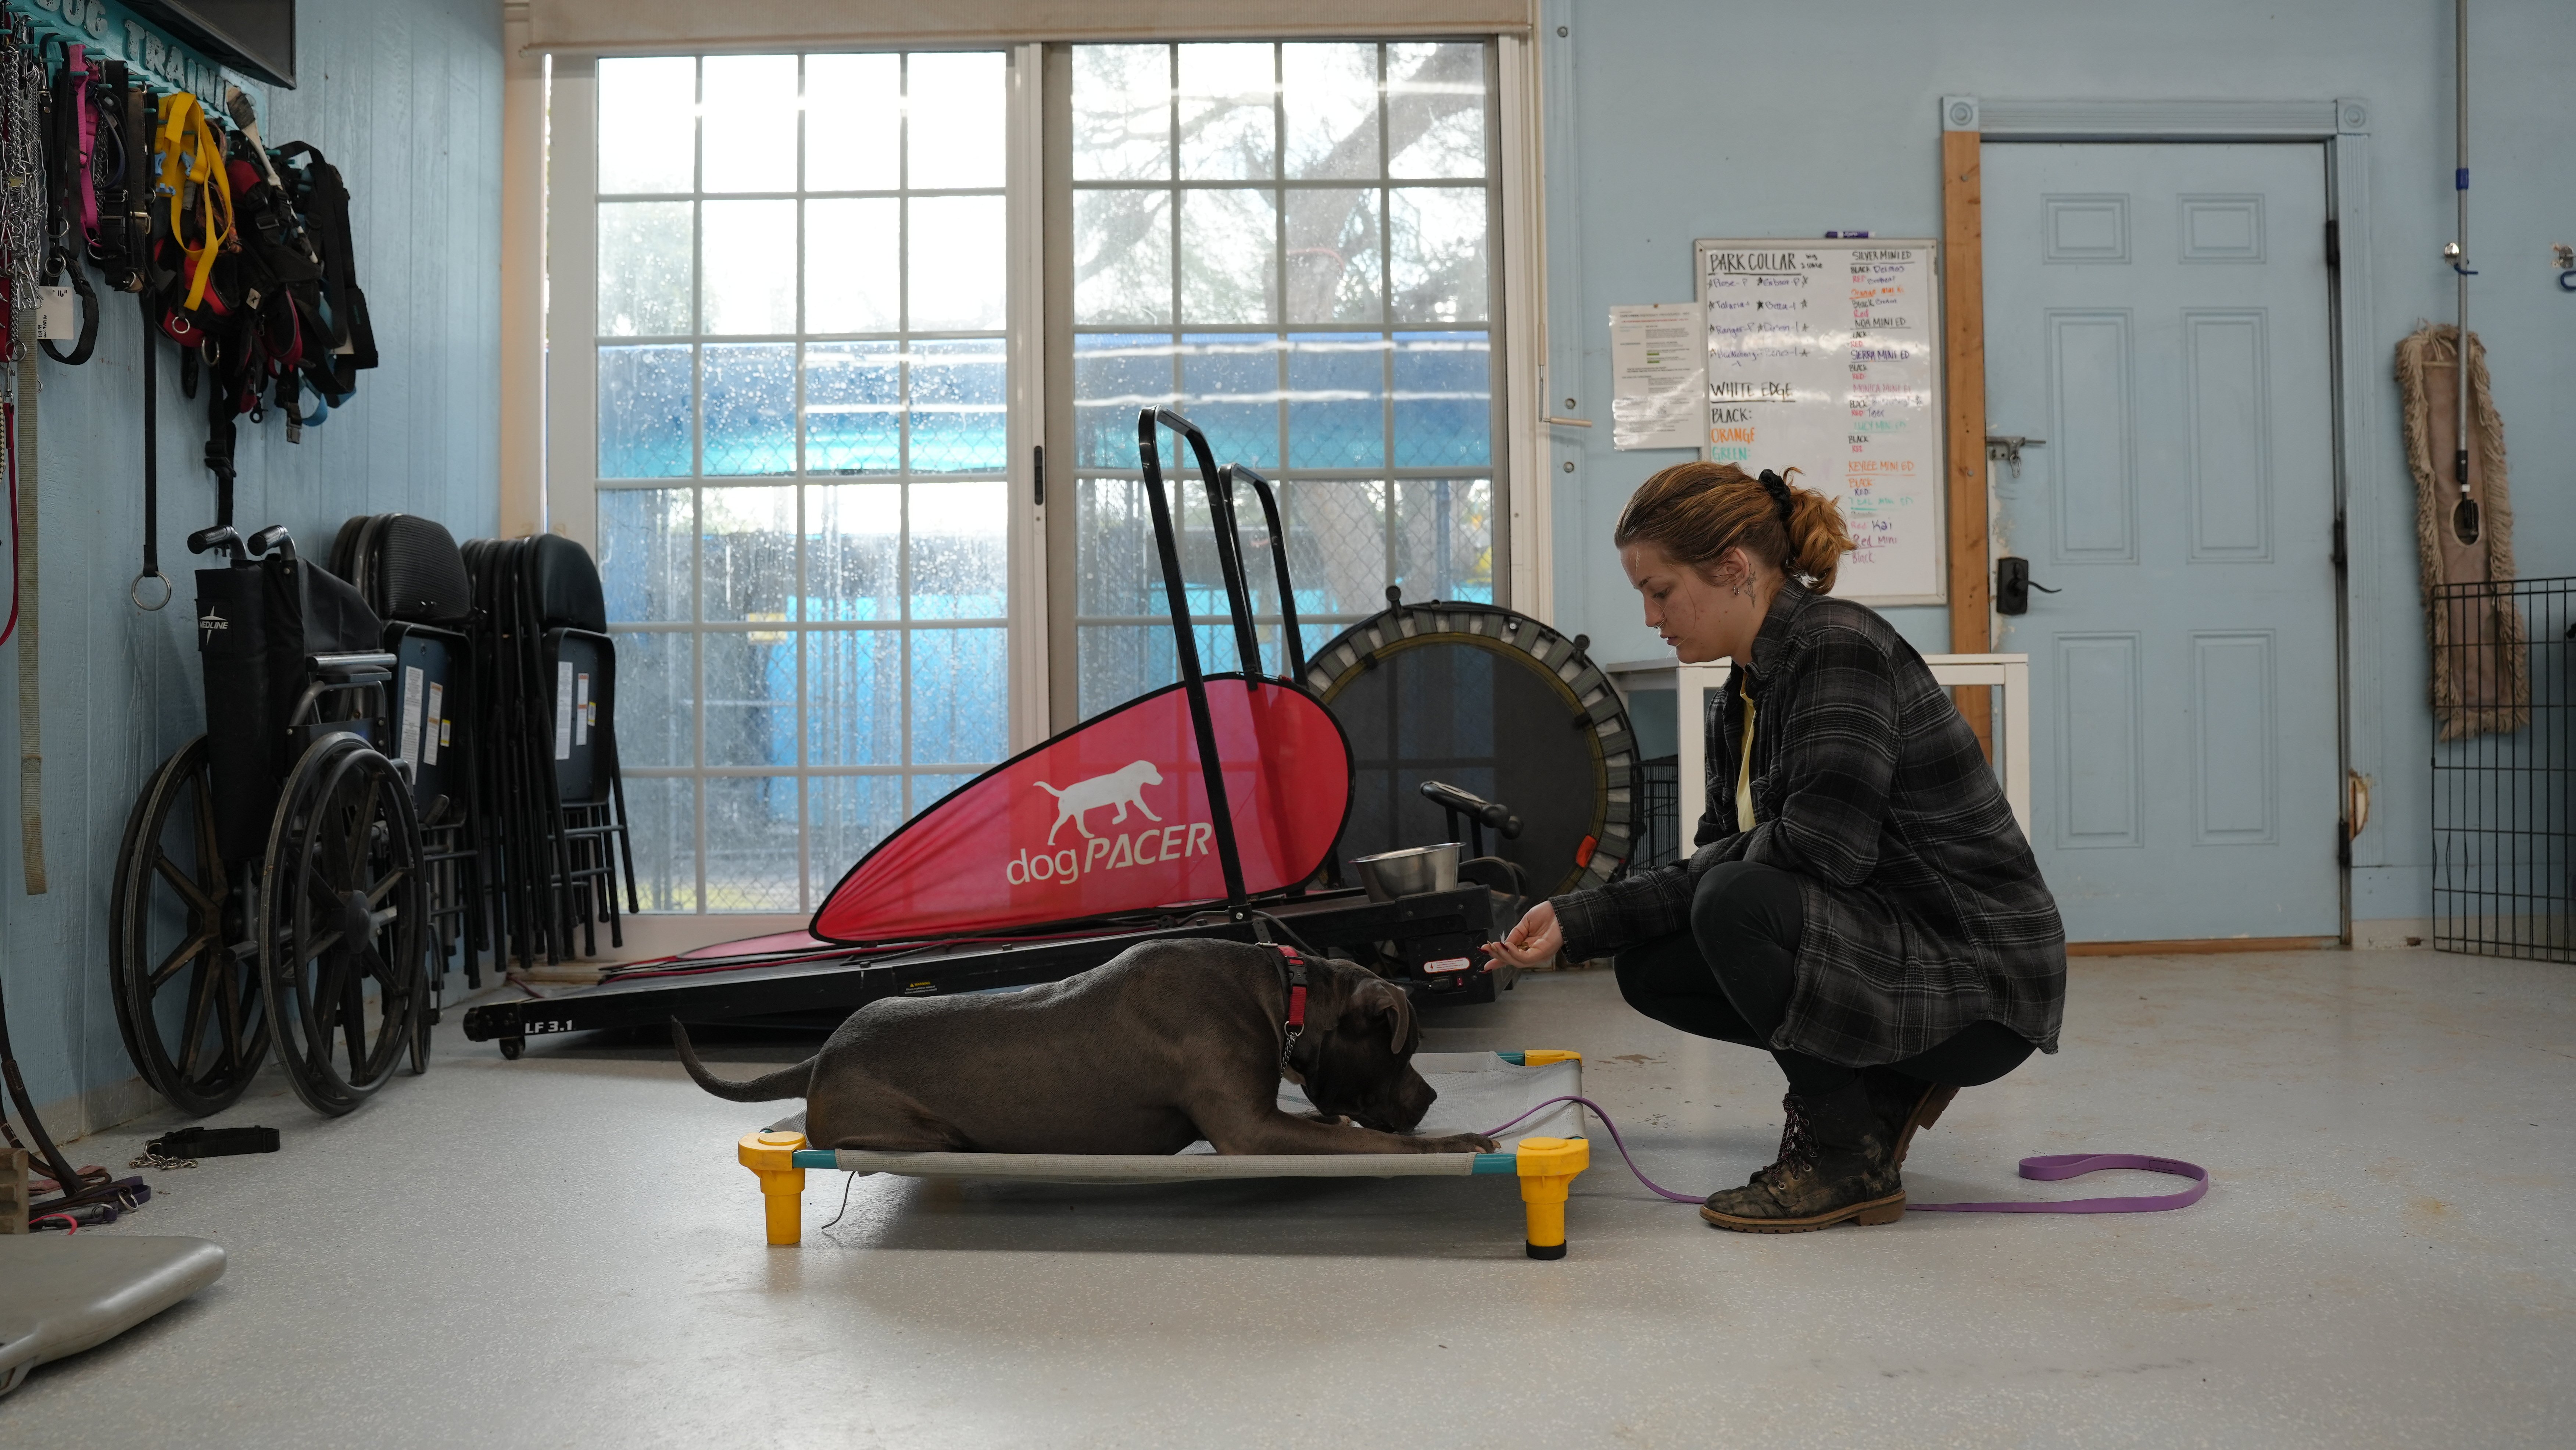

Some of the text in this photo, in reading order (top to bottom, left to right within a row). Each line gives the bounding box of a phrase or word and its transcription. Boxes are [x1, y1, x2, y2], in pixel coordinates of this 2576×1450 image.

[125, 19, 258, 121] TRAINI
[1852, 250, 1911, 261] SILVER MINI ED
[1710, 253, 1796, 272] BARK COLLAR
[1850, 265, 1870, 274] BLACK
[1852, 299, 1874, 309] Black
[1853, 309, 1868, 318] Red
[1873, 318, 1893, 327] MINI
[1895, 318, 1906, 326] ED
[1851, 350, 1909, 360] SIERRA MINI ED
[1710, 382, 1792, 400] WHITE EDGE
[1853, 384, 1880, 393] MONICA
[1711, 408, 1752, 424] BLACK:
[1711, 426, 1755, 444] ORANGE
[1852, 445, 1863, 453] RED
[1849, 460, 1914, 472] KEYLEE MINI ED
[1851, 517, 1892, 532] Red Kai
[1853, 534, 1872, 547] Red
[1852, 551, 1874, 564] Black
[199, 621, 229, 629] MEDLINE
[525, 1019, 573, 1034] LF 3.1
